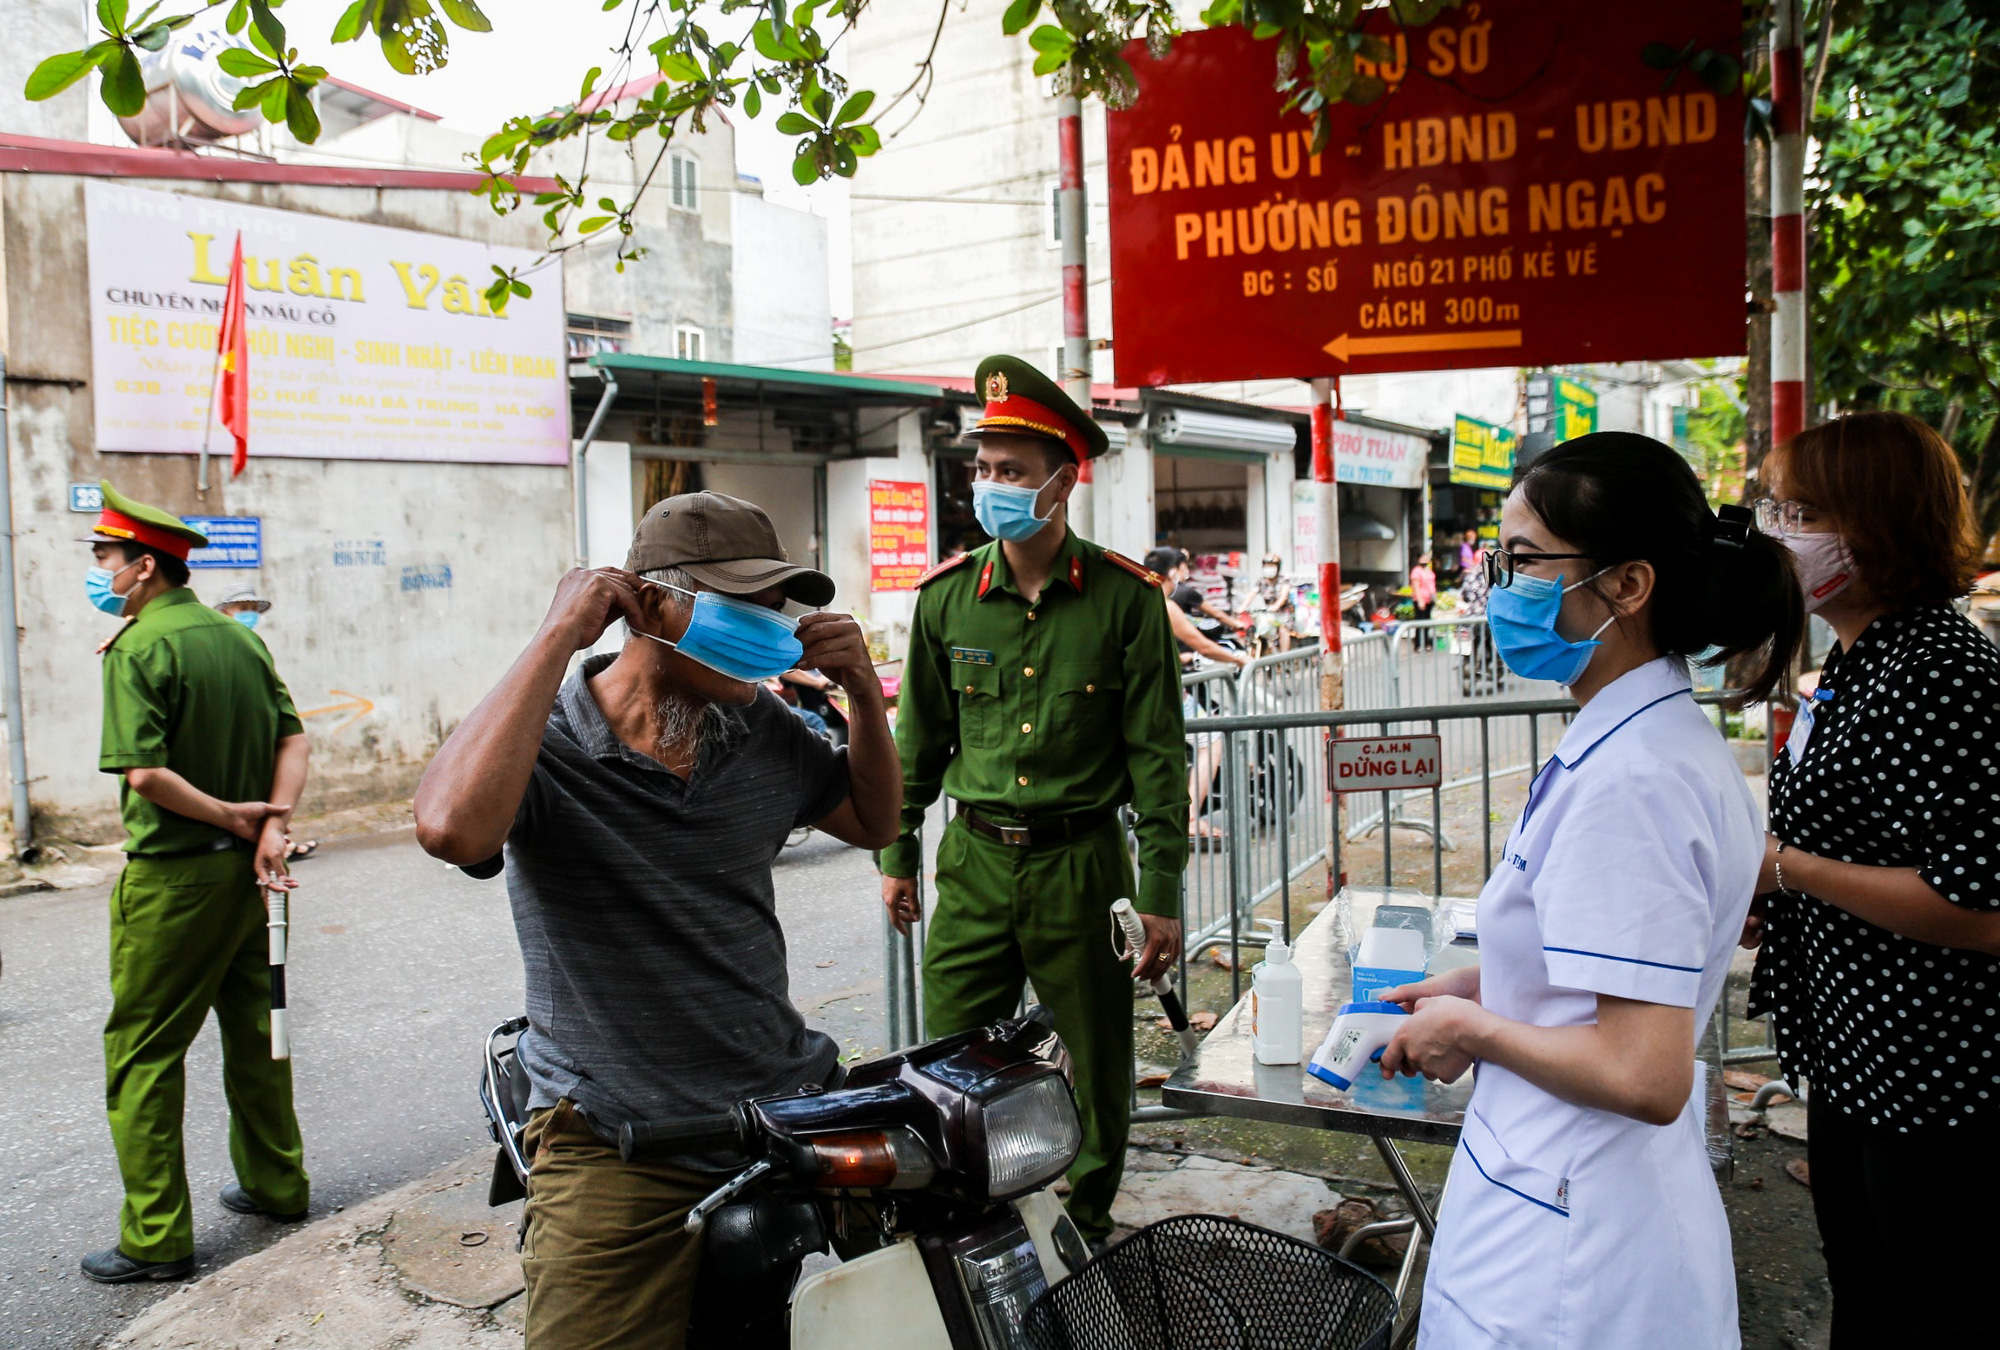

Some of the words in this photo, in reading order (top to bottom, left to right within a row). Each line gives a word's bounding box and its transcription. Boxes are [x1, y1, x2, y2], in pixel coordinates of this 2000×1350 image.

[1428, 4, 1493, 77] SỞ
[1130, 124, 1257, 195] ĐẢNG
[1383, 111, 1518, 171] HĐND
[1576, 92, 1717, 154] UBND
[1175, 191, 1362, 260] PHƯỜNG
[1376, 183, 1509, 245] ĐÔNG
[1528, 172, 1667, 238] NGẠC
[187, 231, 366, 303] Luân
[1306, 258, 1339, 293] SỐ
[1430, 258, 1455, 285] 21
[1463, 246, 1514, 283] PHỐ
[106, 286, 194, 311] CHUYÊN
[201, 298, 255, 317] NHN
[1360, 296, 1426, 329] CÁCH
[1444, 296, 1519, 325] 300m
[107, 313, 159, 351] TIỆC
[285, 334, 335, 367] NGHỊ
[355, 340, 401, 367] SINH
[405, 343, 453, 376] NHẬT
[512, 354, 557, 380] HOAN
[1340, 756, 1397, 778] DỪNG
[1402, 758, 1434, 778] LẠI
[1362, 742, 1411, 755] C.A.H.N
[985, 1252, 1035, 1276] HONDA
